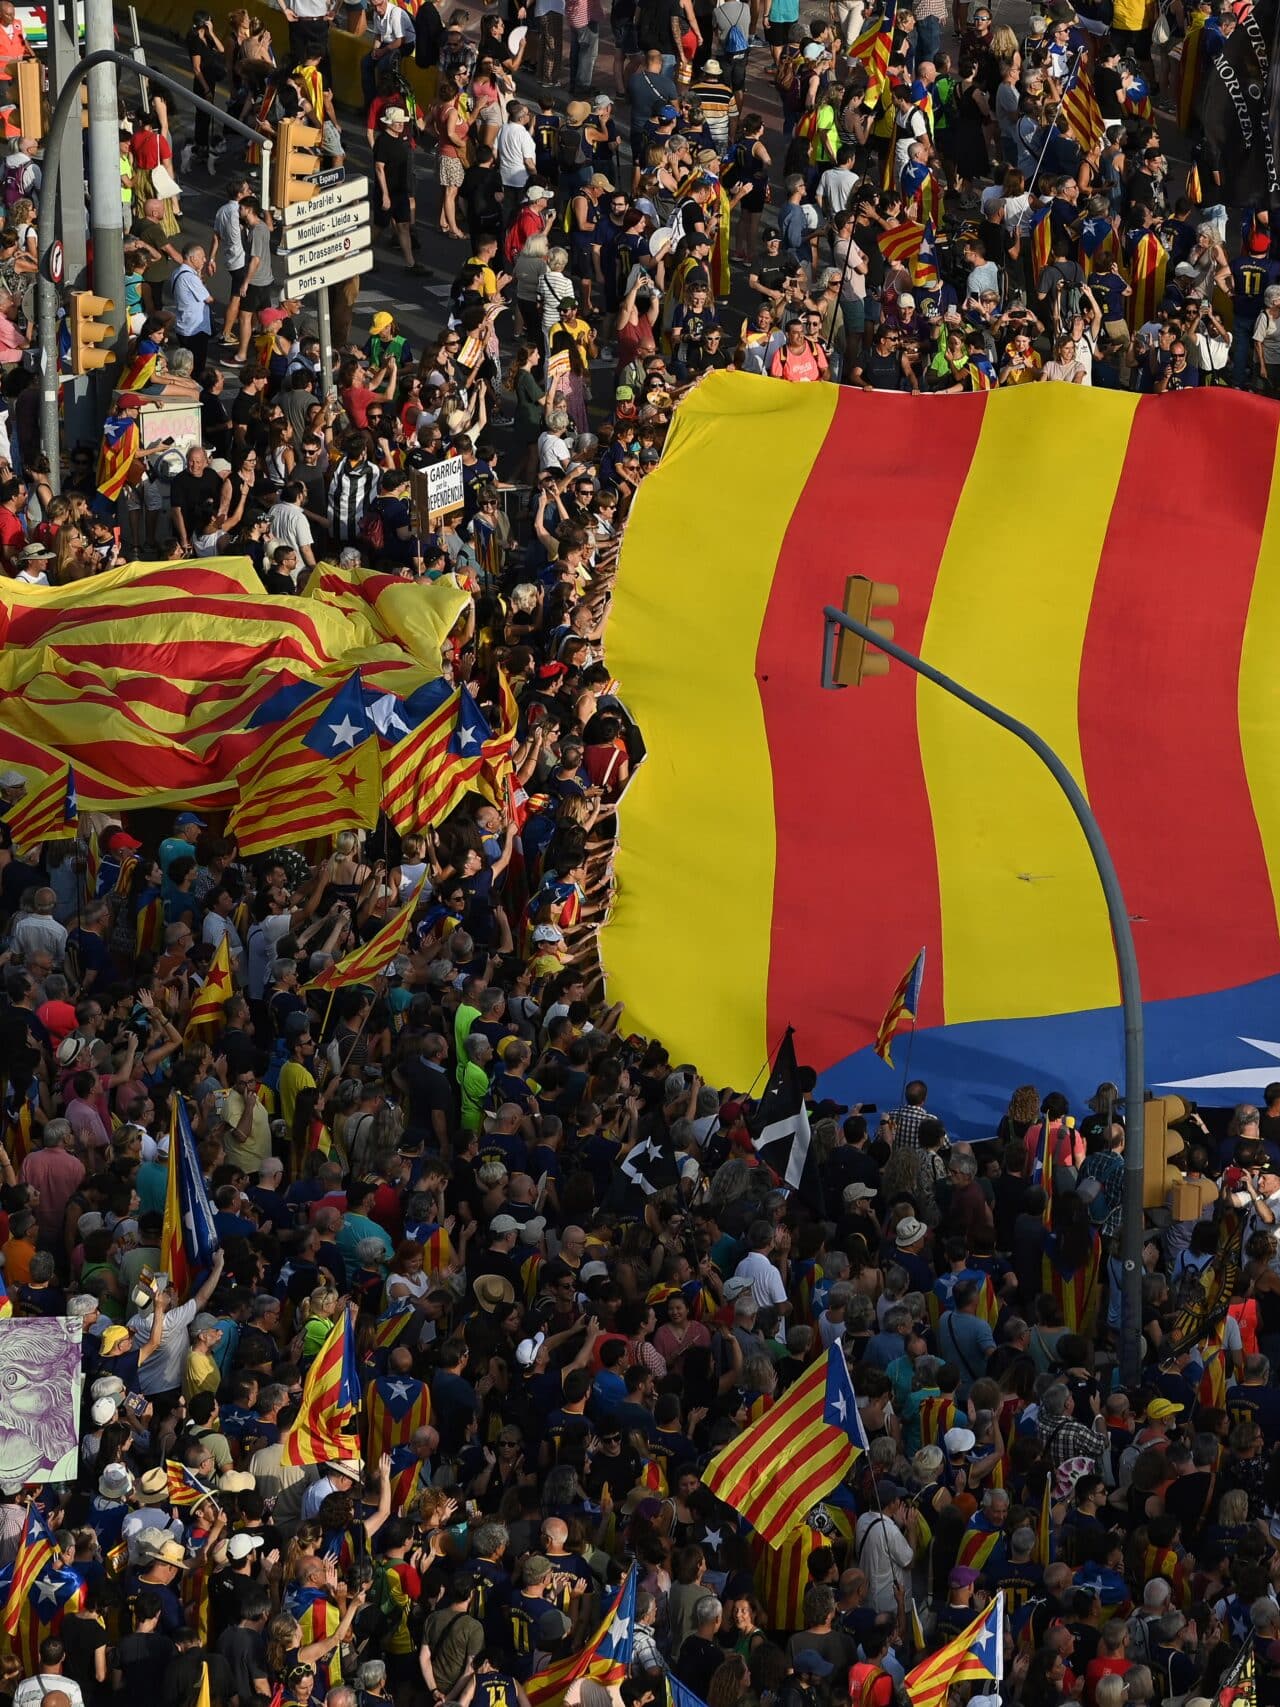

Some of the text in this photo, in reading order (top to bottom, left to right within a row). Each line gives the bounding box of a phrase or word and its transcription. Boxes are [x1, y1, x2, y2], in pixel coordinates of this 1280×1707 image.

[319, 172, 339, 184] Espanya
[296, 204, 307, 217] Av.
[331, 212, 351, 229] Lleida
[299, 241, 343, 266] Pl. Drassanes
[298, 275, 317, 291] Ports
[1243, 271, 1261, 295] 11
[430, 458, 462, 482] GARRIGA
